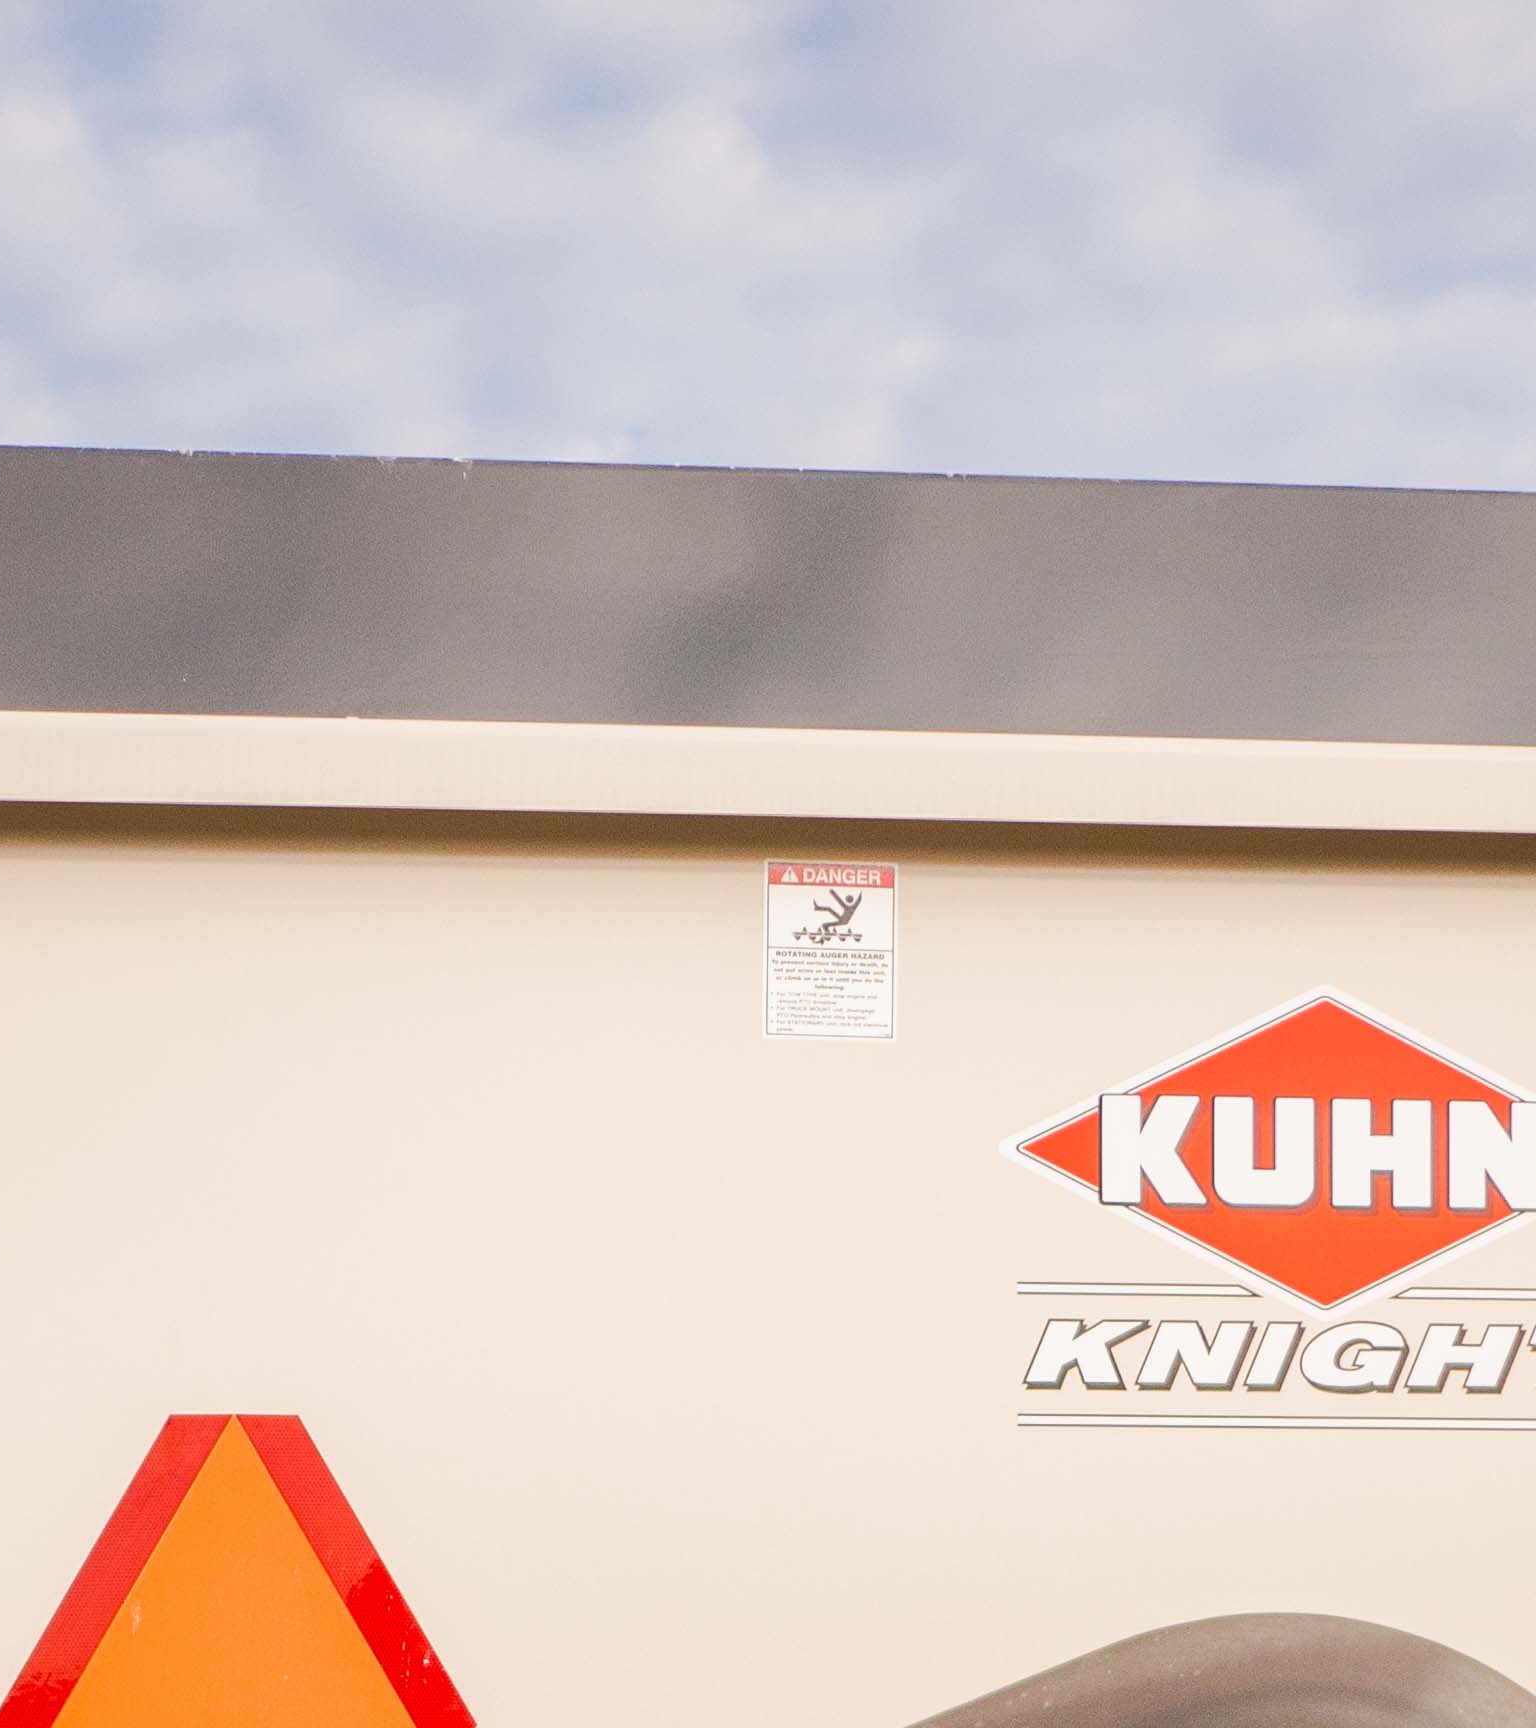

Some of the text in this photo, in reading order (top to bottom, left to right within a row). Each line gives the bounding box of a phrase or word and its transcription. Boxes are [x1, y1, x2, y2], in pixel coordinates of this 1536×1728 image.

[803, 868, 881, 885] DANGER
[775, 950, 885, 960] ROTATING AUGER HAZARD
